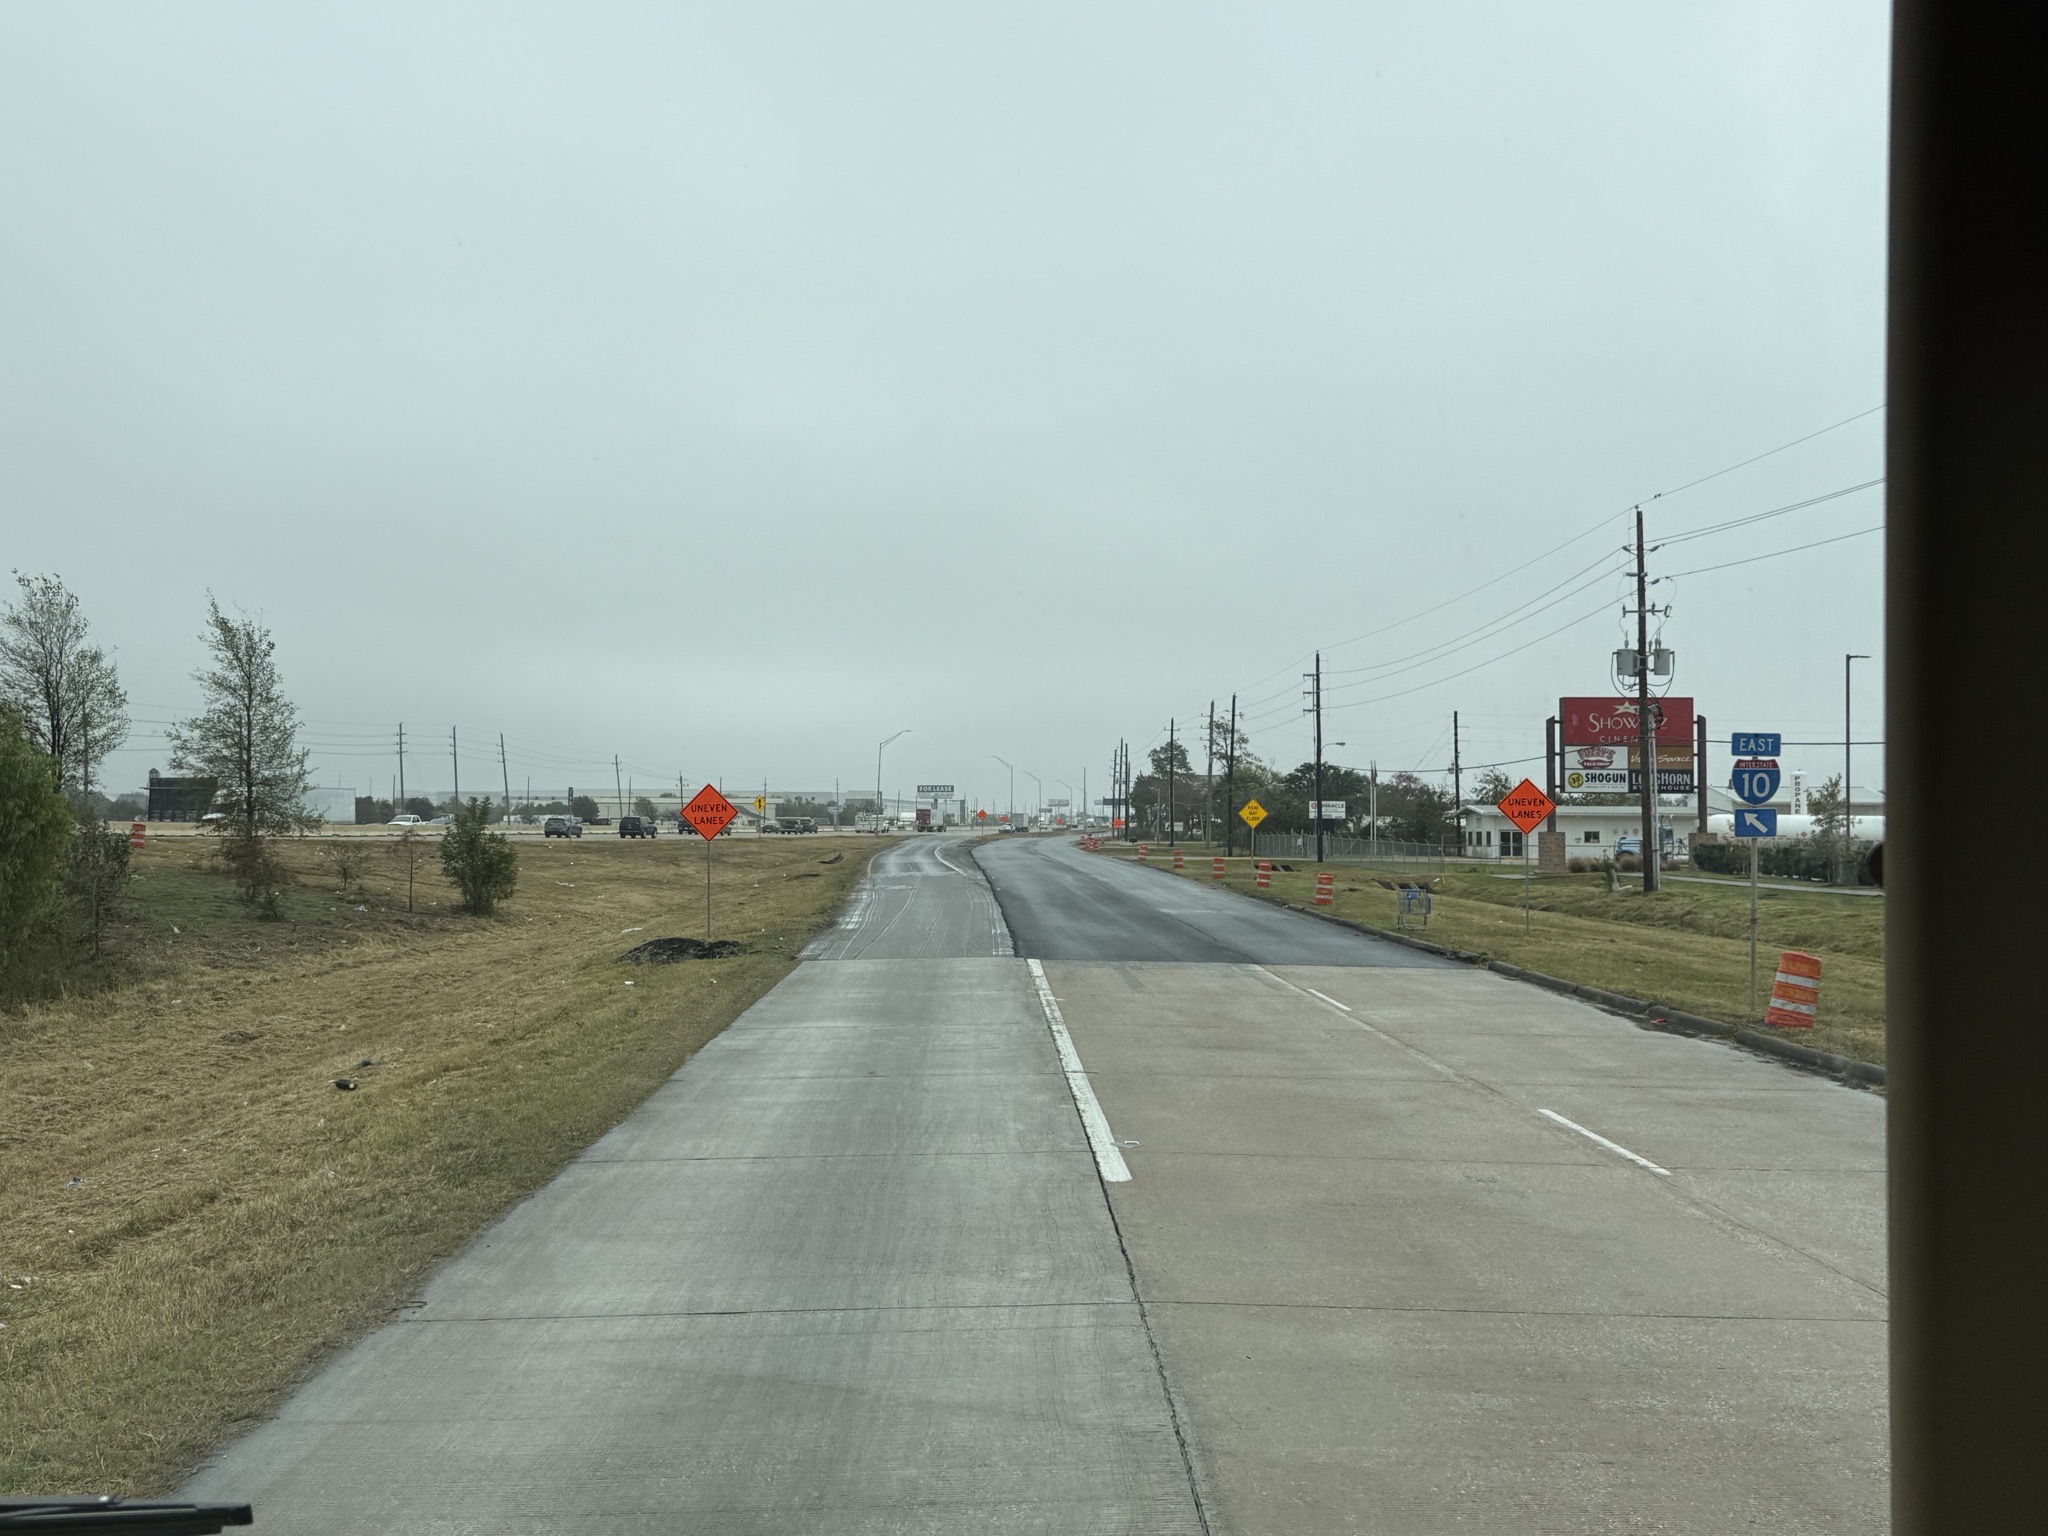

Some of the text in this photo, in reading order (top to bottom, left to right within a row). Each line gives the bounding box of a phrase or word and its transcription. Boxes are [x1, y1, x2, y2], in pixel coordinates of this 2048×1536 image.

[1740, 738, 1774, 751] EAST
[1585, 773, 1626, 783] SHOGUN
[1742, 772, 1770, 797] 10
[1508, 798, 1545, 806] UNEVEN
[691, 804, 727, 813] UNEVEN
[1511, 811, 1542, 819] LANES
[694, 817, 724, 825] LANES
